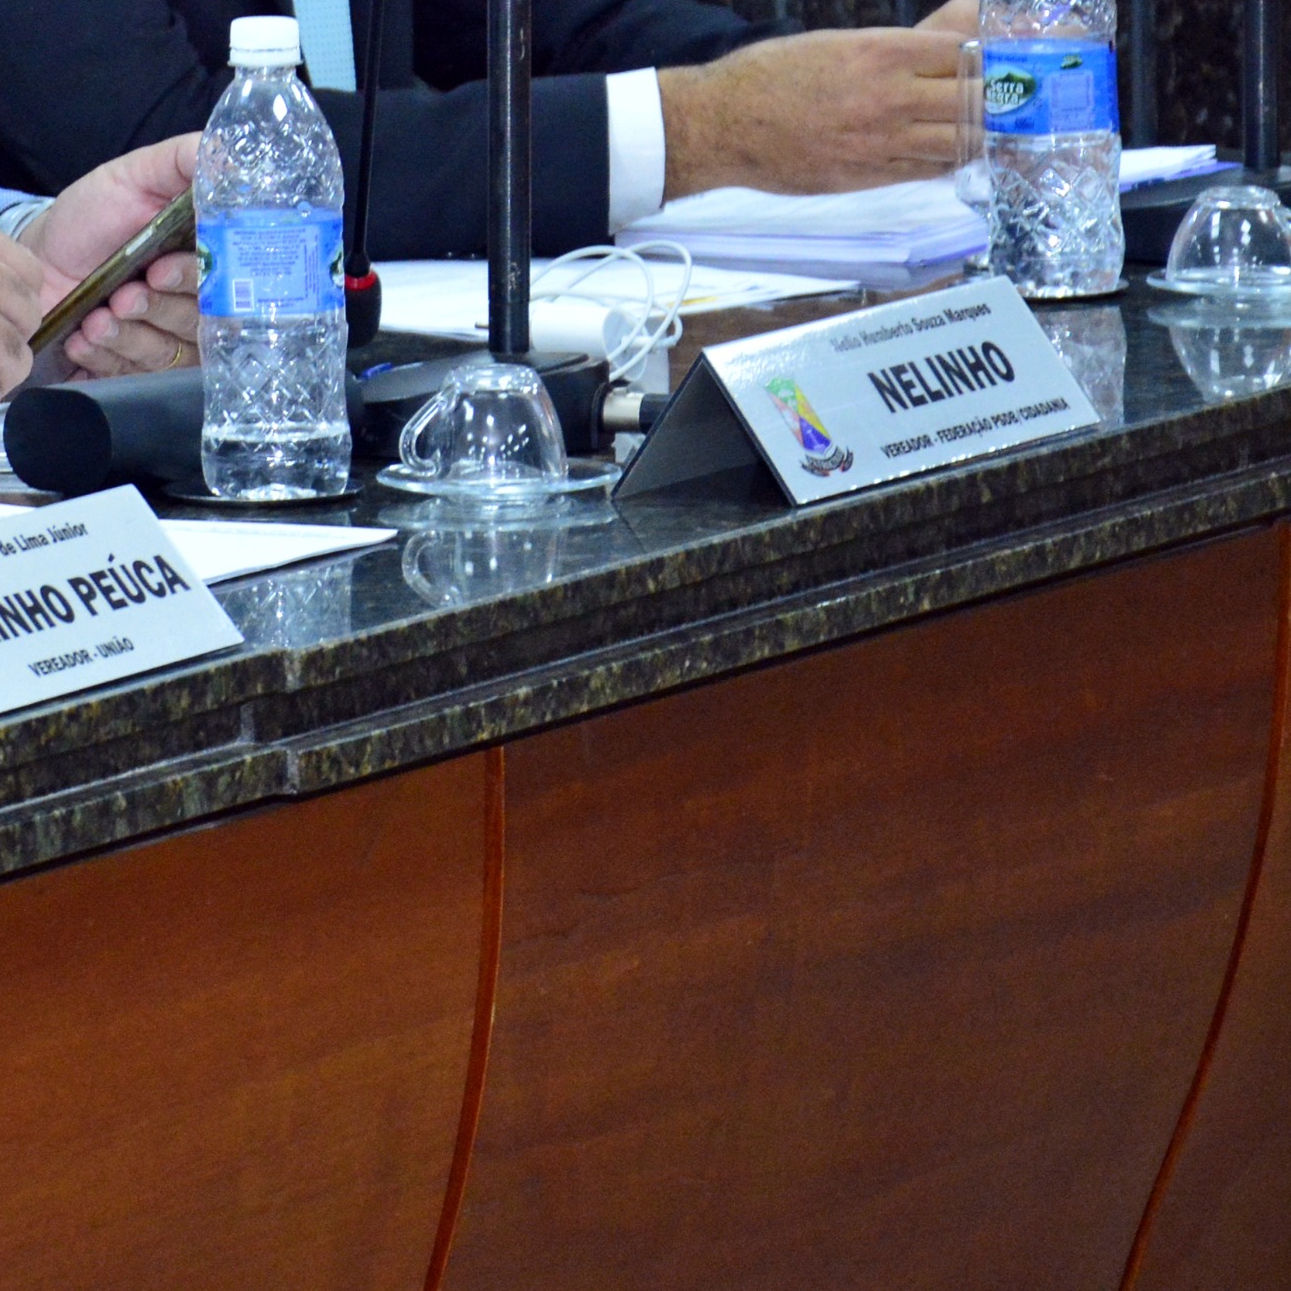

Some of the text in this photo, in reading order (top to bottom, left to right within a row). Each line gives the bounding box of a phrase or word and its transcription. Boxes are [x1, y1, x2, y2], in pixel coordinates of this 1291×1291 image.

[990, 79, 1025, 95] Serra
[859, 321, 914, 347] Humberto
[911, 315, 946, 332] Souza
[943, 302, 992, 324] Marques
[867, 340, 1015, 414] NELINHO
[880, 434, 934, 460] VEREADOR
[936, 416, 993, 445] FEDERAÇÃO
[13, 534, 50, 553] Lima
[48, 521, 89, 544] Júnior
[67, 553, 191, 617] PEÚCA
[28, 648, 94, 678] VEREADOR
[96, 636, 135, 660] UNIÃO
